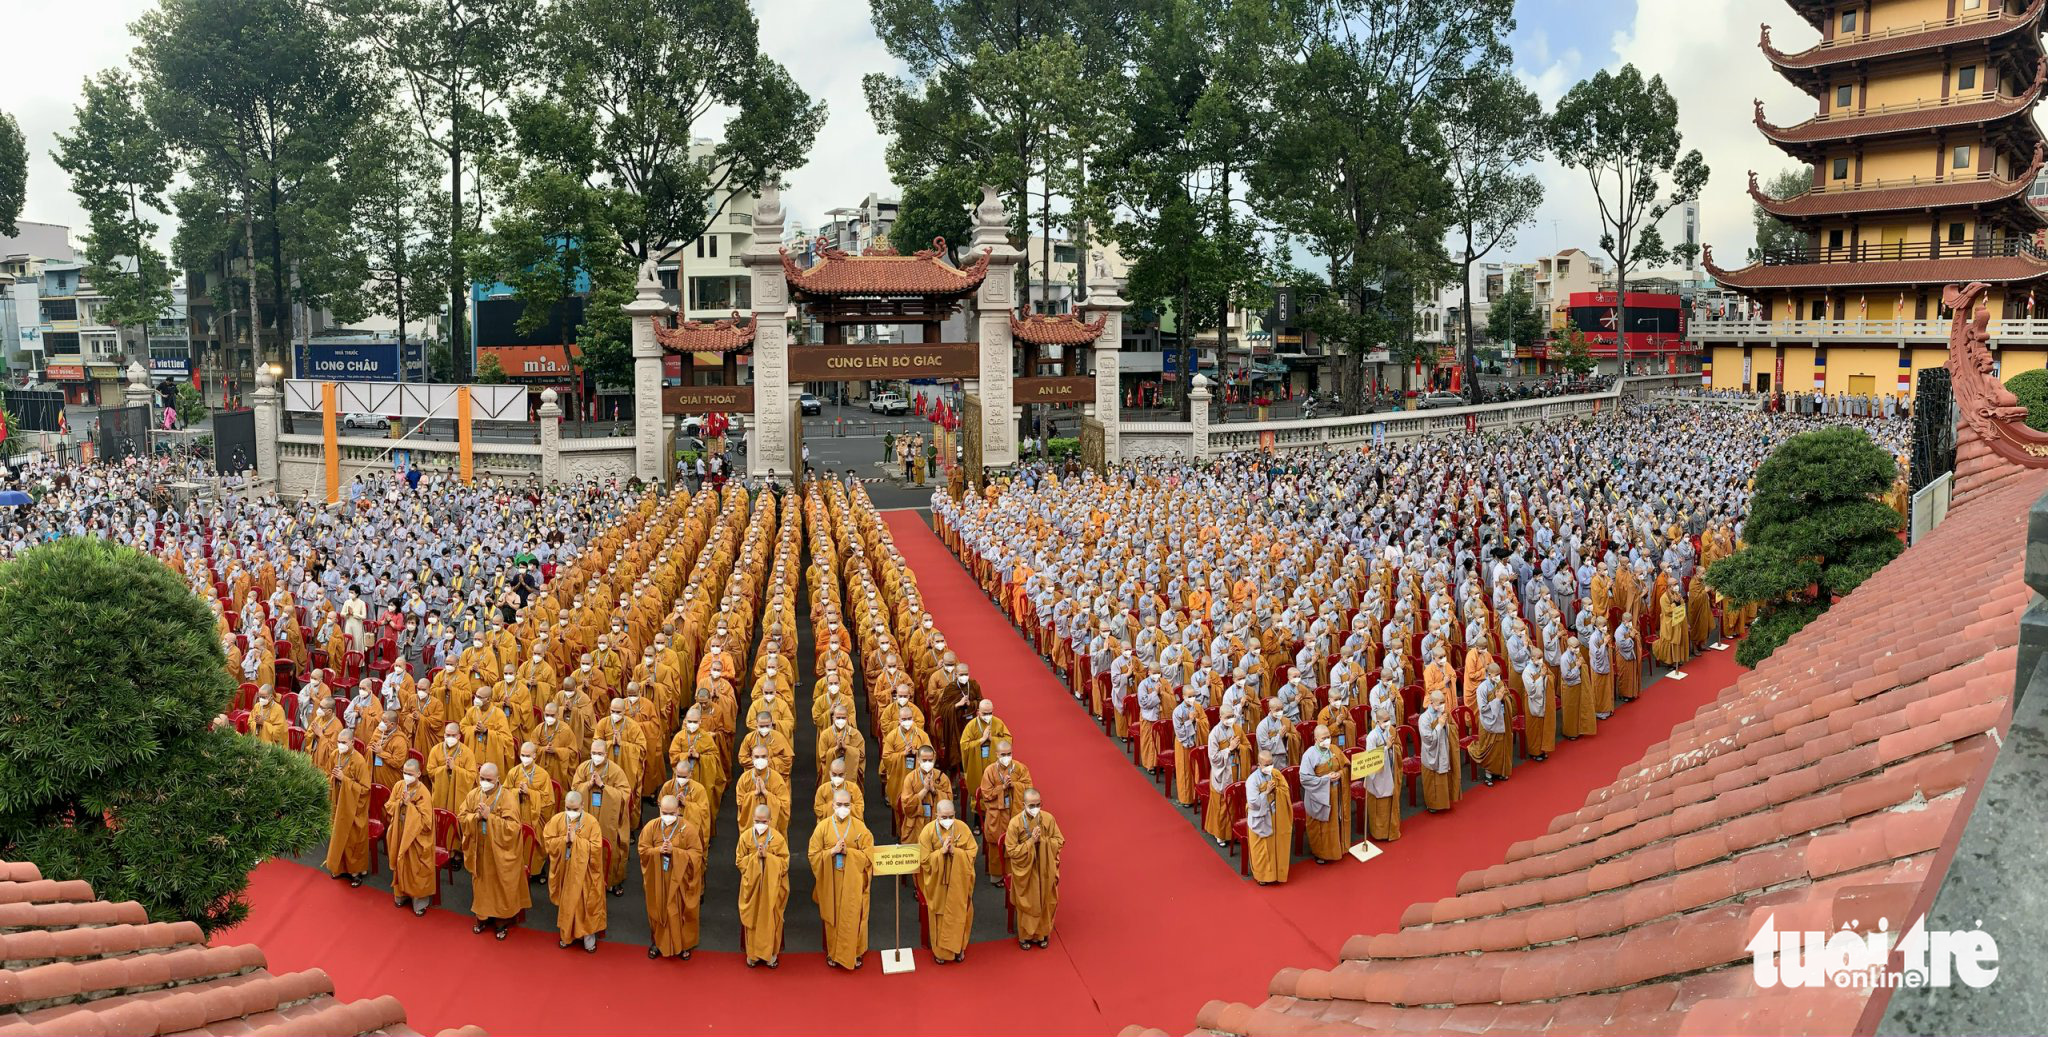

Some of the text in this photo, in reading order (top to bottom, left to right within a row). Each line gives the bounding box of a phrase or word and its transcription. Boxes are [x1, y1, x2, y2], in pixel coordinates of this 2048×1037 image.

[316, 358, 378, 371] LONG CHÂU
[827, 354, 943, 369] CÙNG LÊN BỜ GIÁC
[1038, 386, 1072, 395] AN LẠC
[680, 393, 737, 405] GIẢI THOÁT
